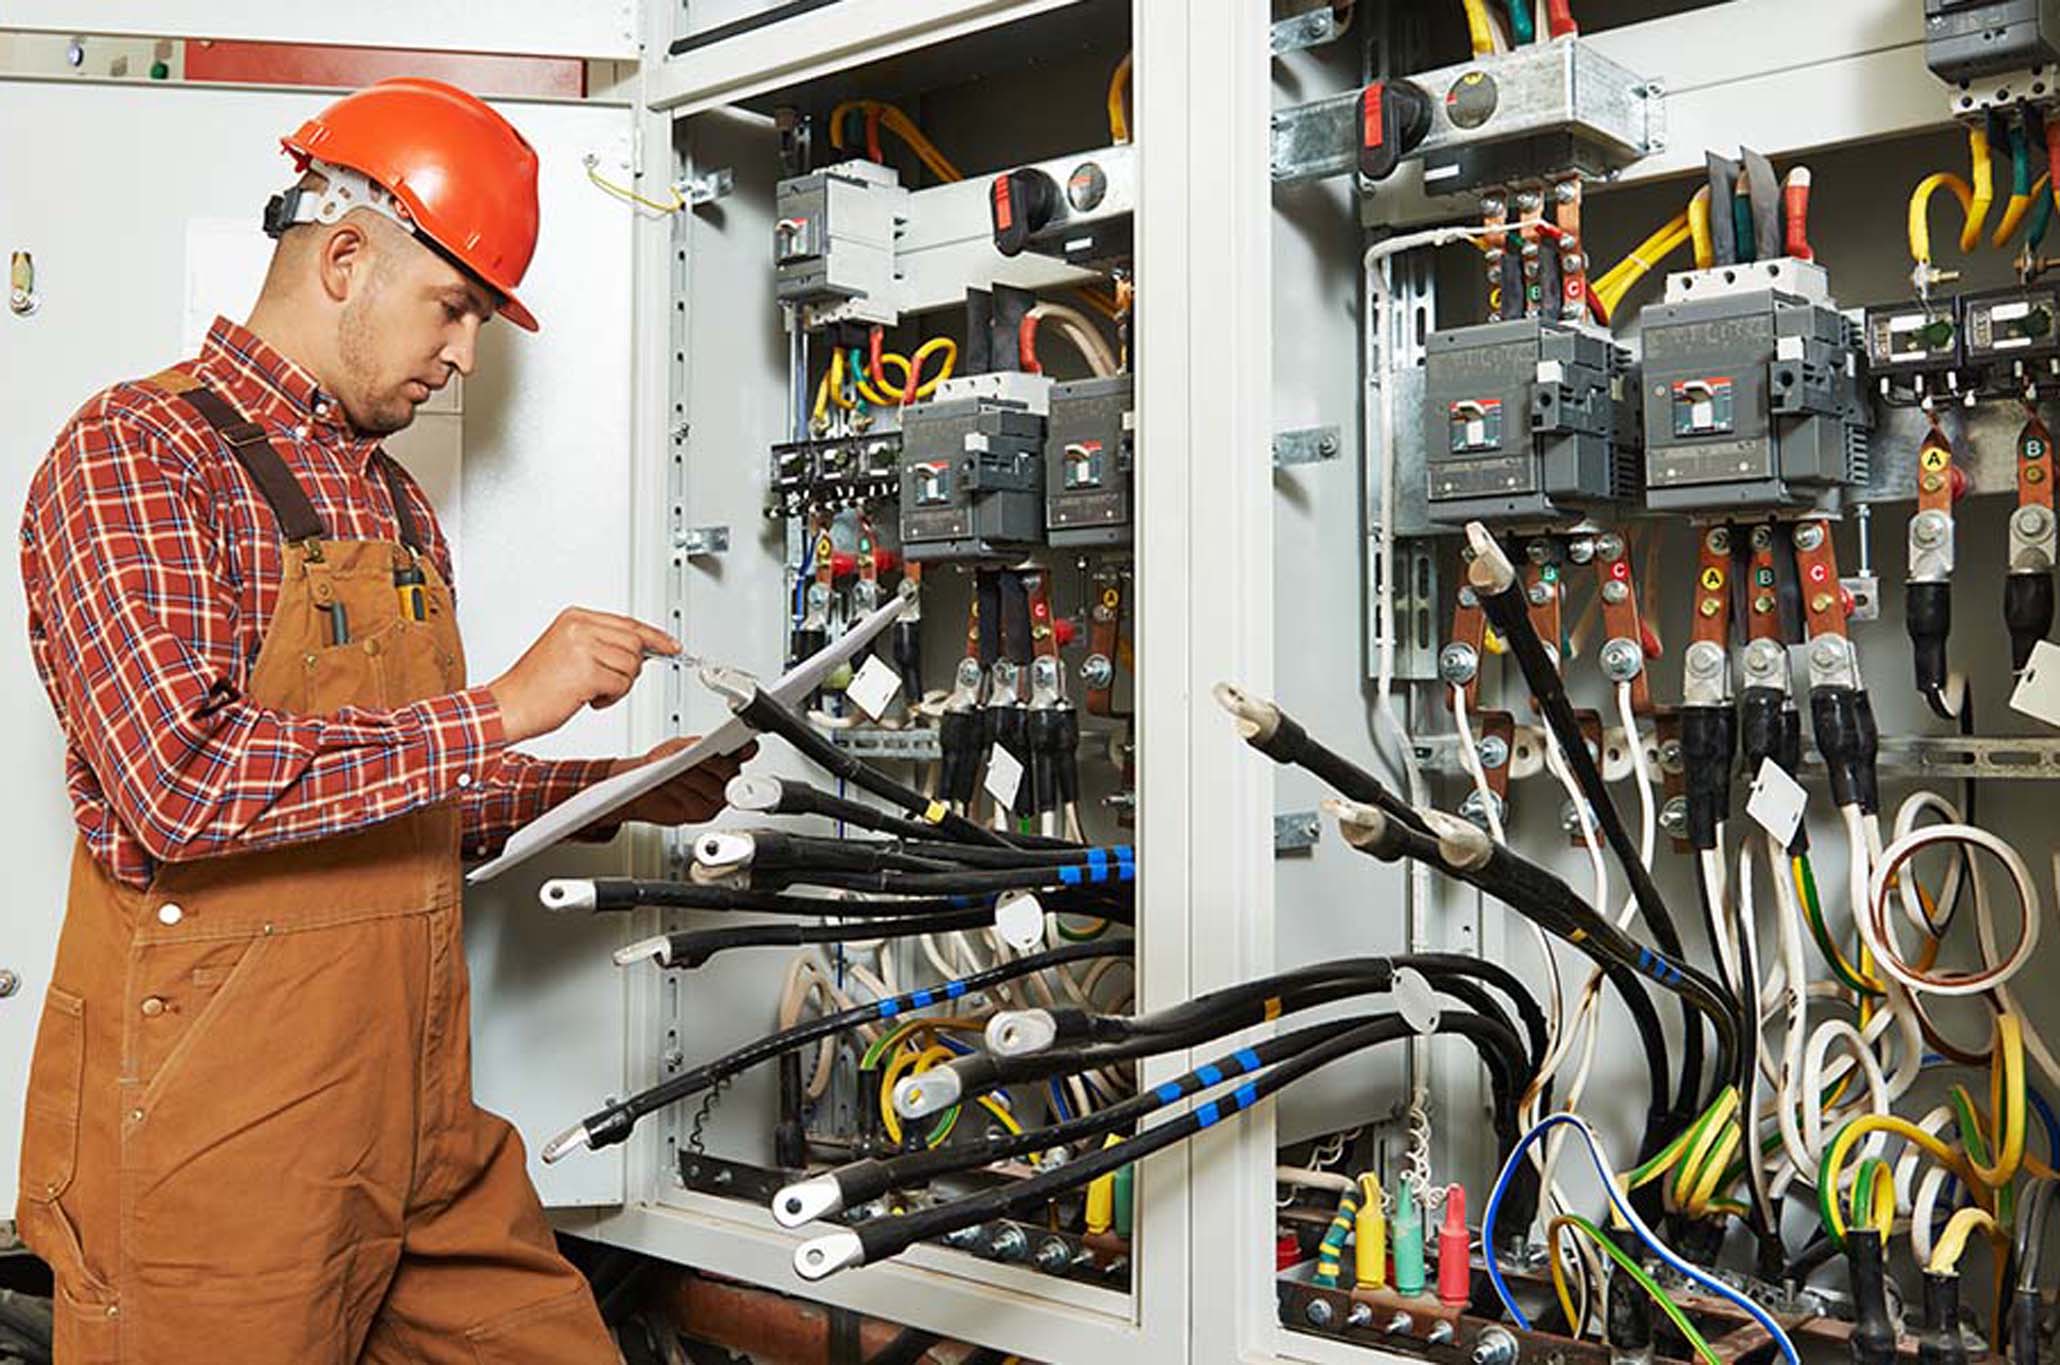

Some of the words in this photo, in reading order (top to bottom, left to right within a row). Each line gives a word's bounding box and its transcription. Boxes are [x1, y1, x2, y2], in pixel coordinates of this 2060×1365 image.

[1567, 281, 1580, 297] C
[2026, 439, 2042, 457] B
[1927, 451, 1942, 466] A
[1613, 562, 1626, 578] C
[1706, 570, 1721, 585] A
[1760, 569, 1773, 584] B
[1810, 564, 1825, 581] C
[1034, 603, 1046, 617] C
